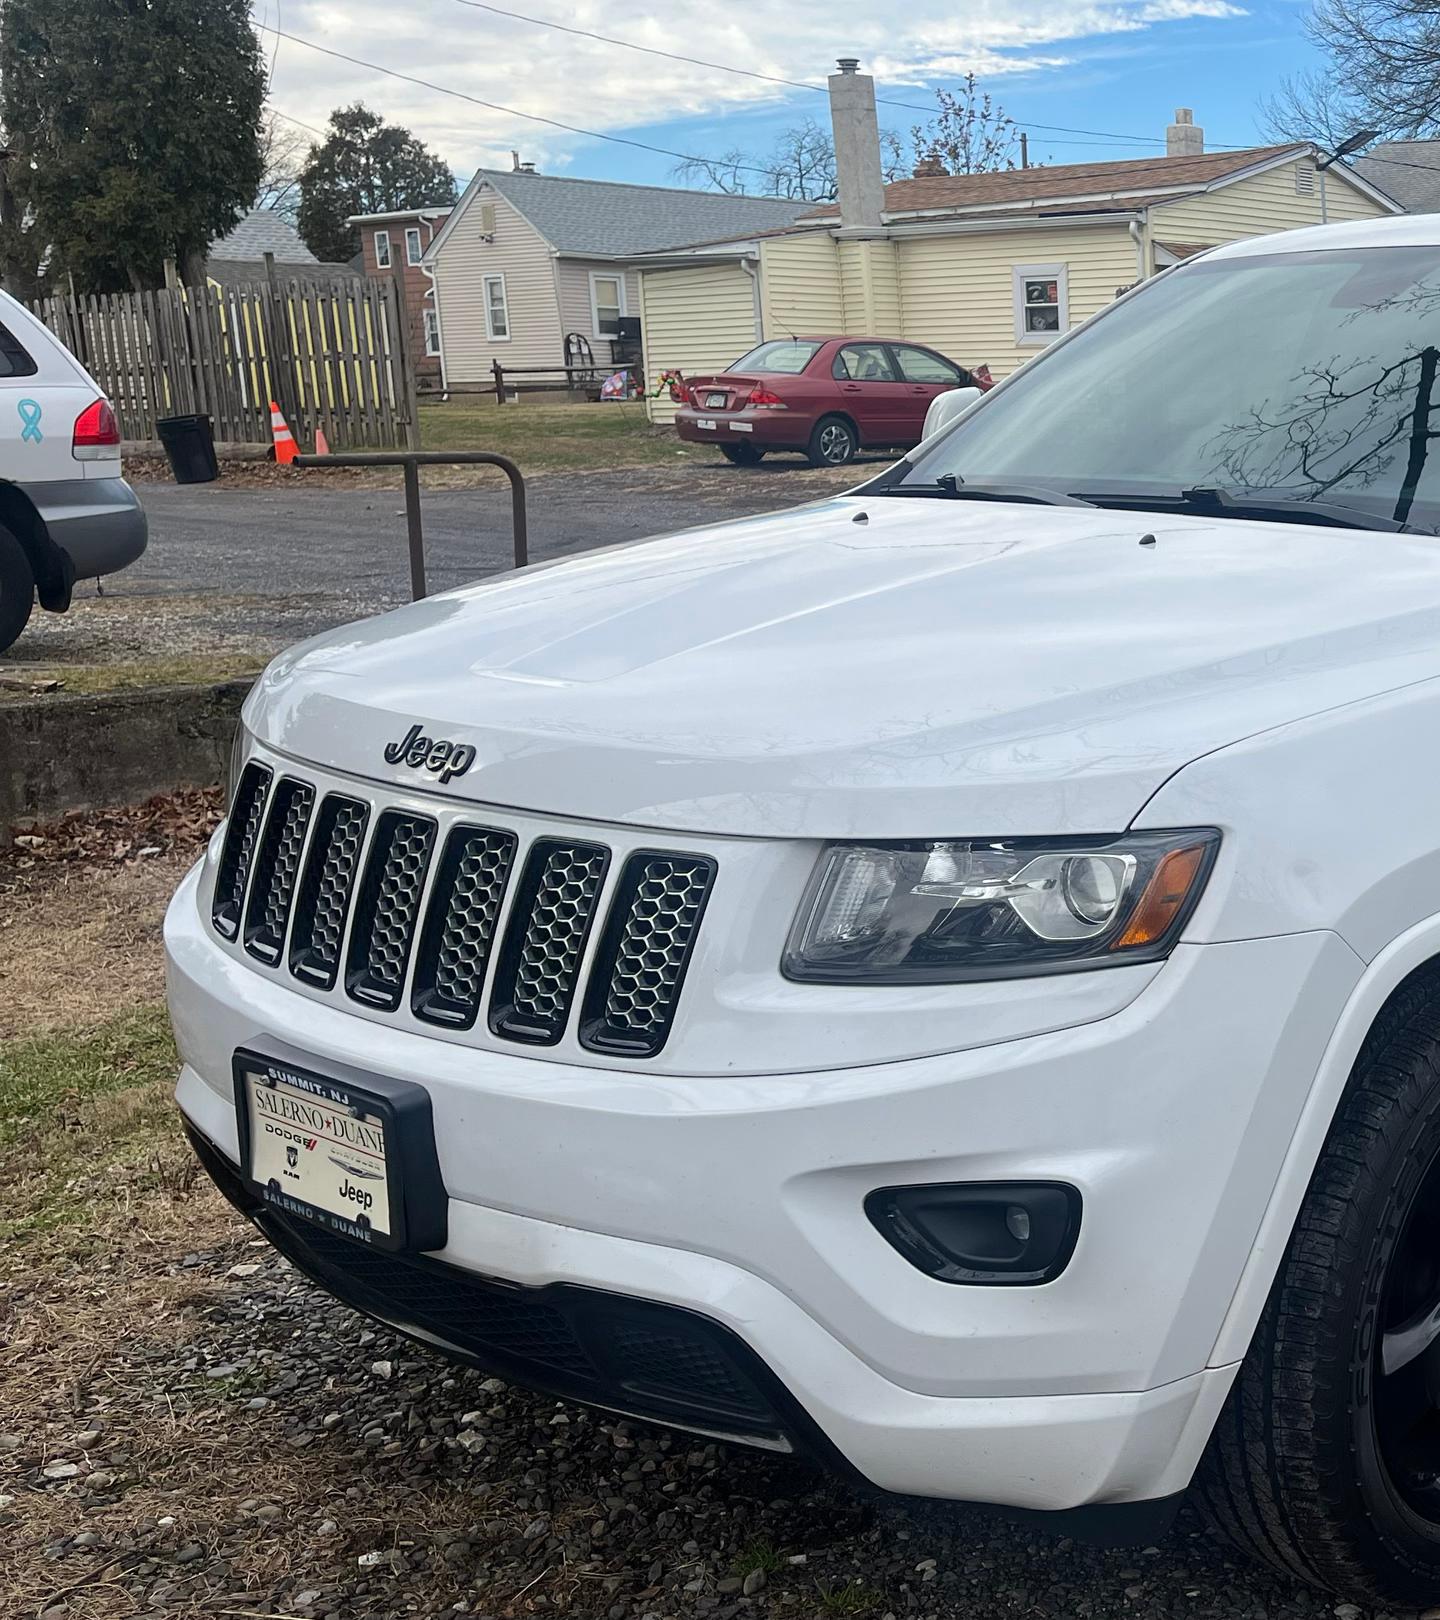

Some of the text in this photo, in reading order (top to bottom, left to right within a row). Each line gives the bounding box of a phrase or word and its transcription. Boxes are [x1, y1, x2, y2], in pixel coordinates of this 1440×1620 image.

[384, 725, 476, 785] Jeep
[268, 1067, 350, 1105] SUMMIT, NJ
[256, 1088, 324, 1131] SALERNO
[265, 1123, 311, 1145] DODGE
[283, 1169, 300, 1181] RAM
[339, 1178, 373, 1211] Jeep
[263, 1189, 372, 1243] SALERNO DUANE
